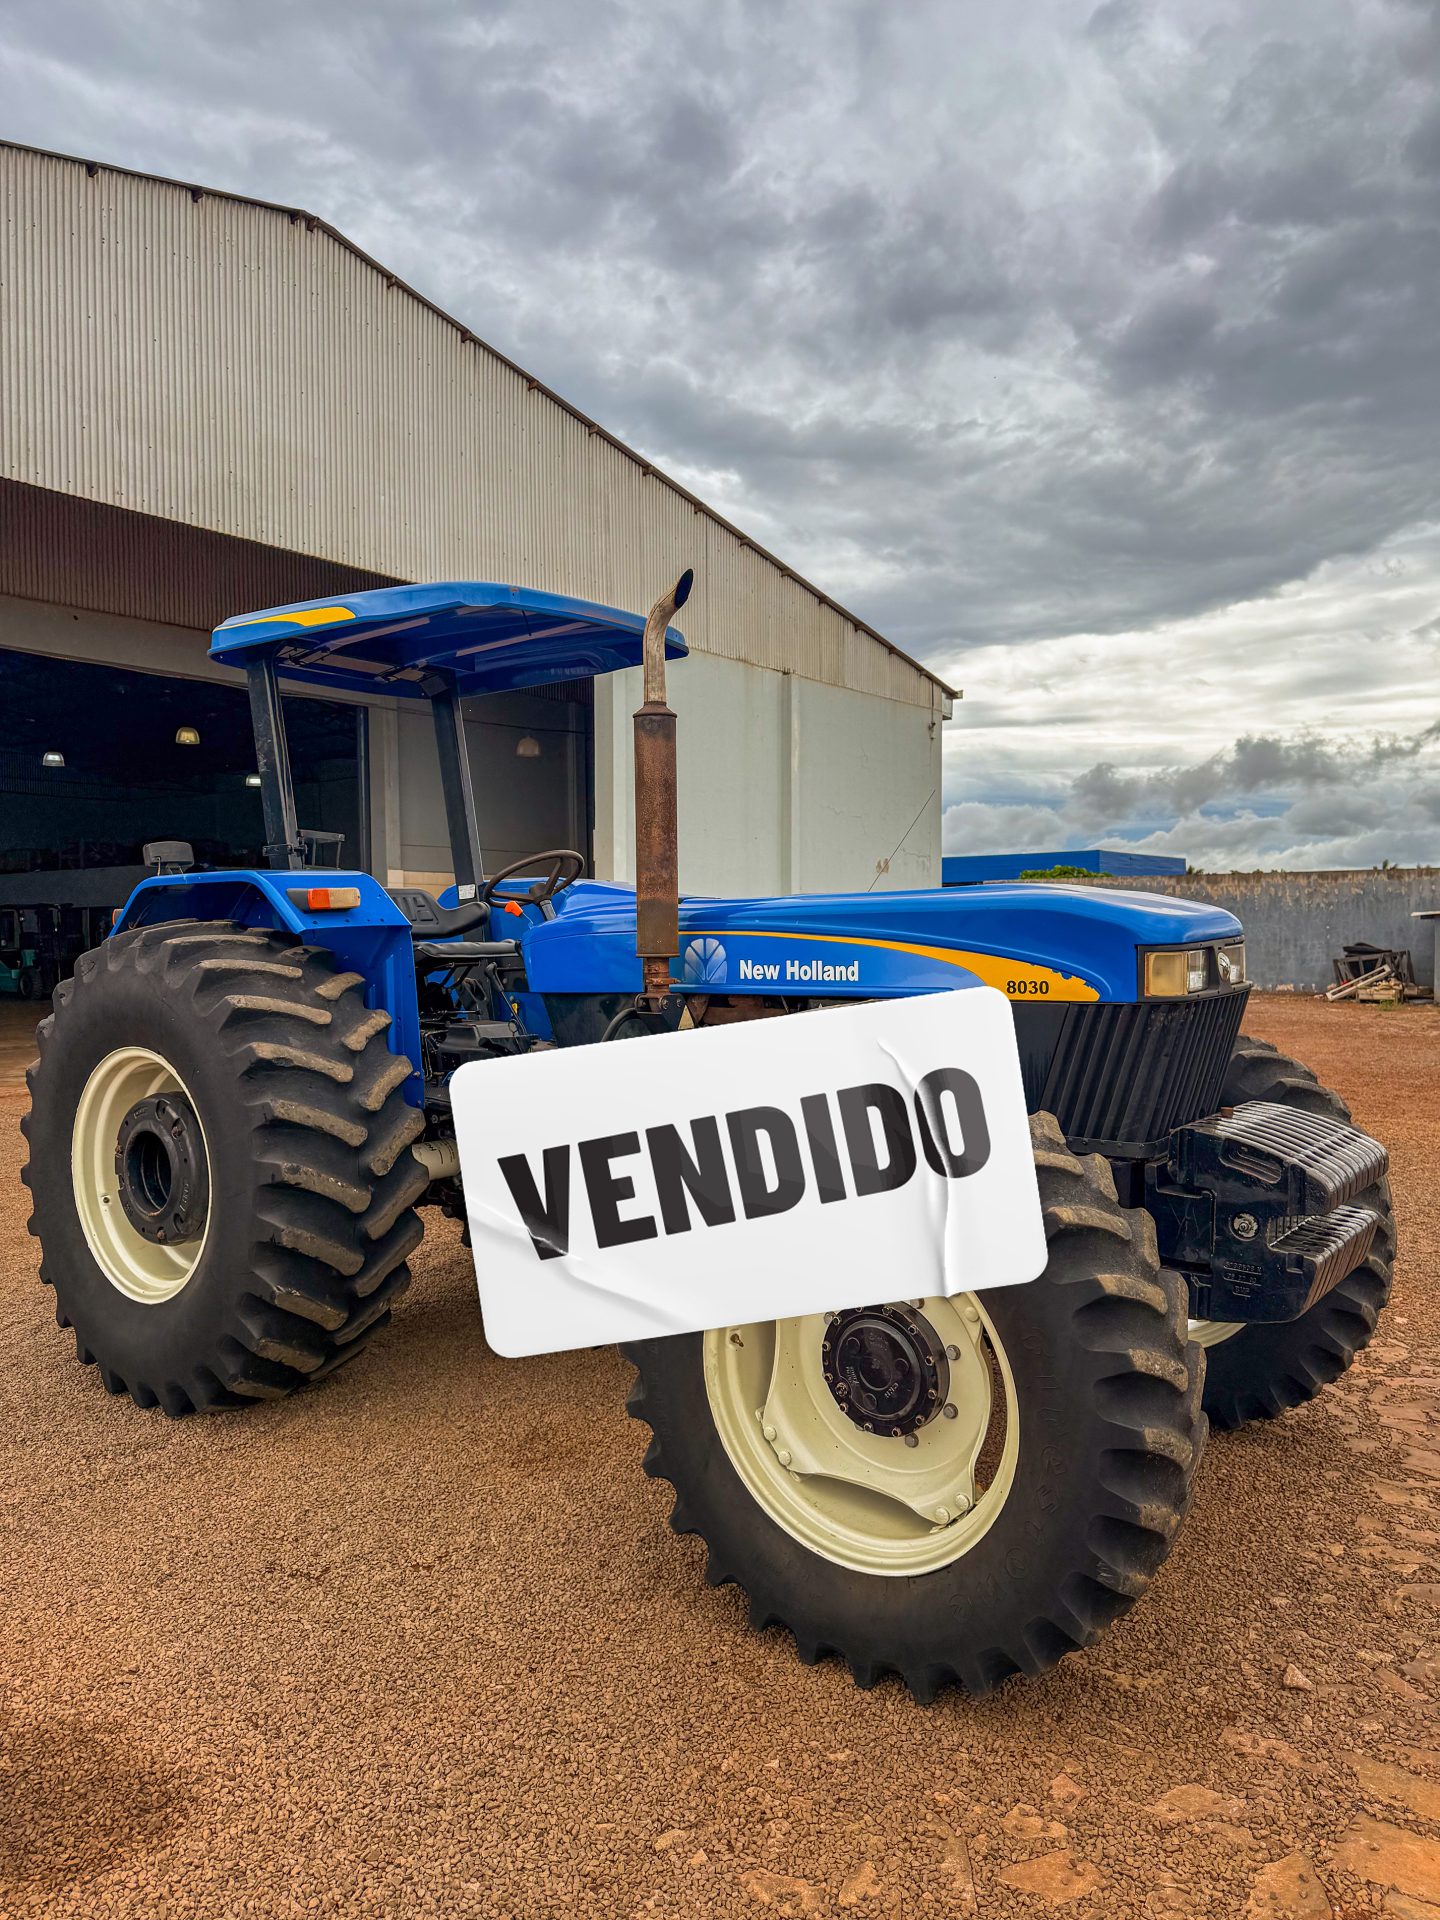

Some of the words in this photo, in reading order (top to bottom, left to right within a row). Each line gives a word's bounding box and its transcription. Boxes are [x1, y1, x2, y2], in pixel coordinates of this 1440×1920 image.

[739, 959, 781, 980] New
[785, 960, 859, 982] Holland
[1006, 980, 1049, 995] 8030
